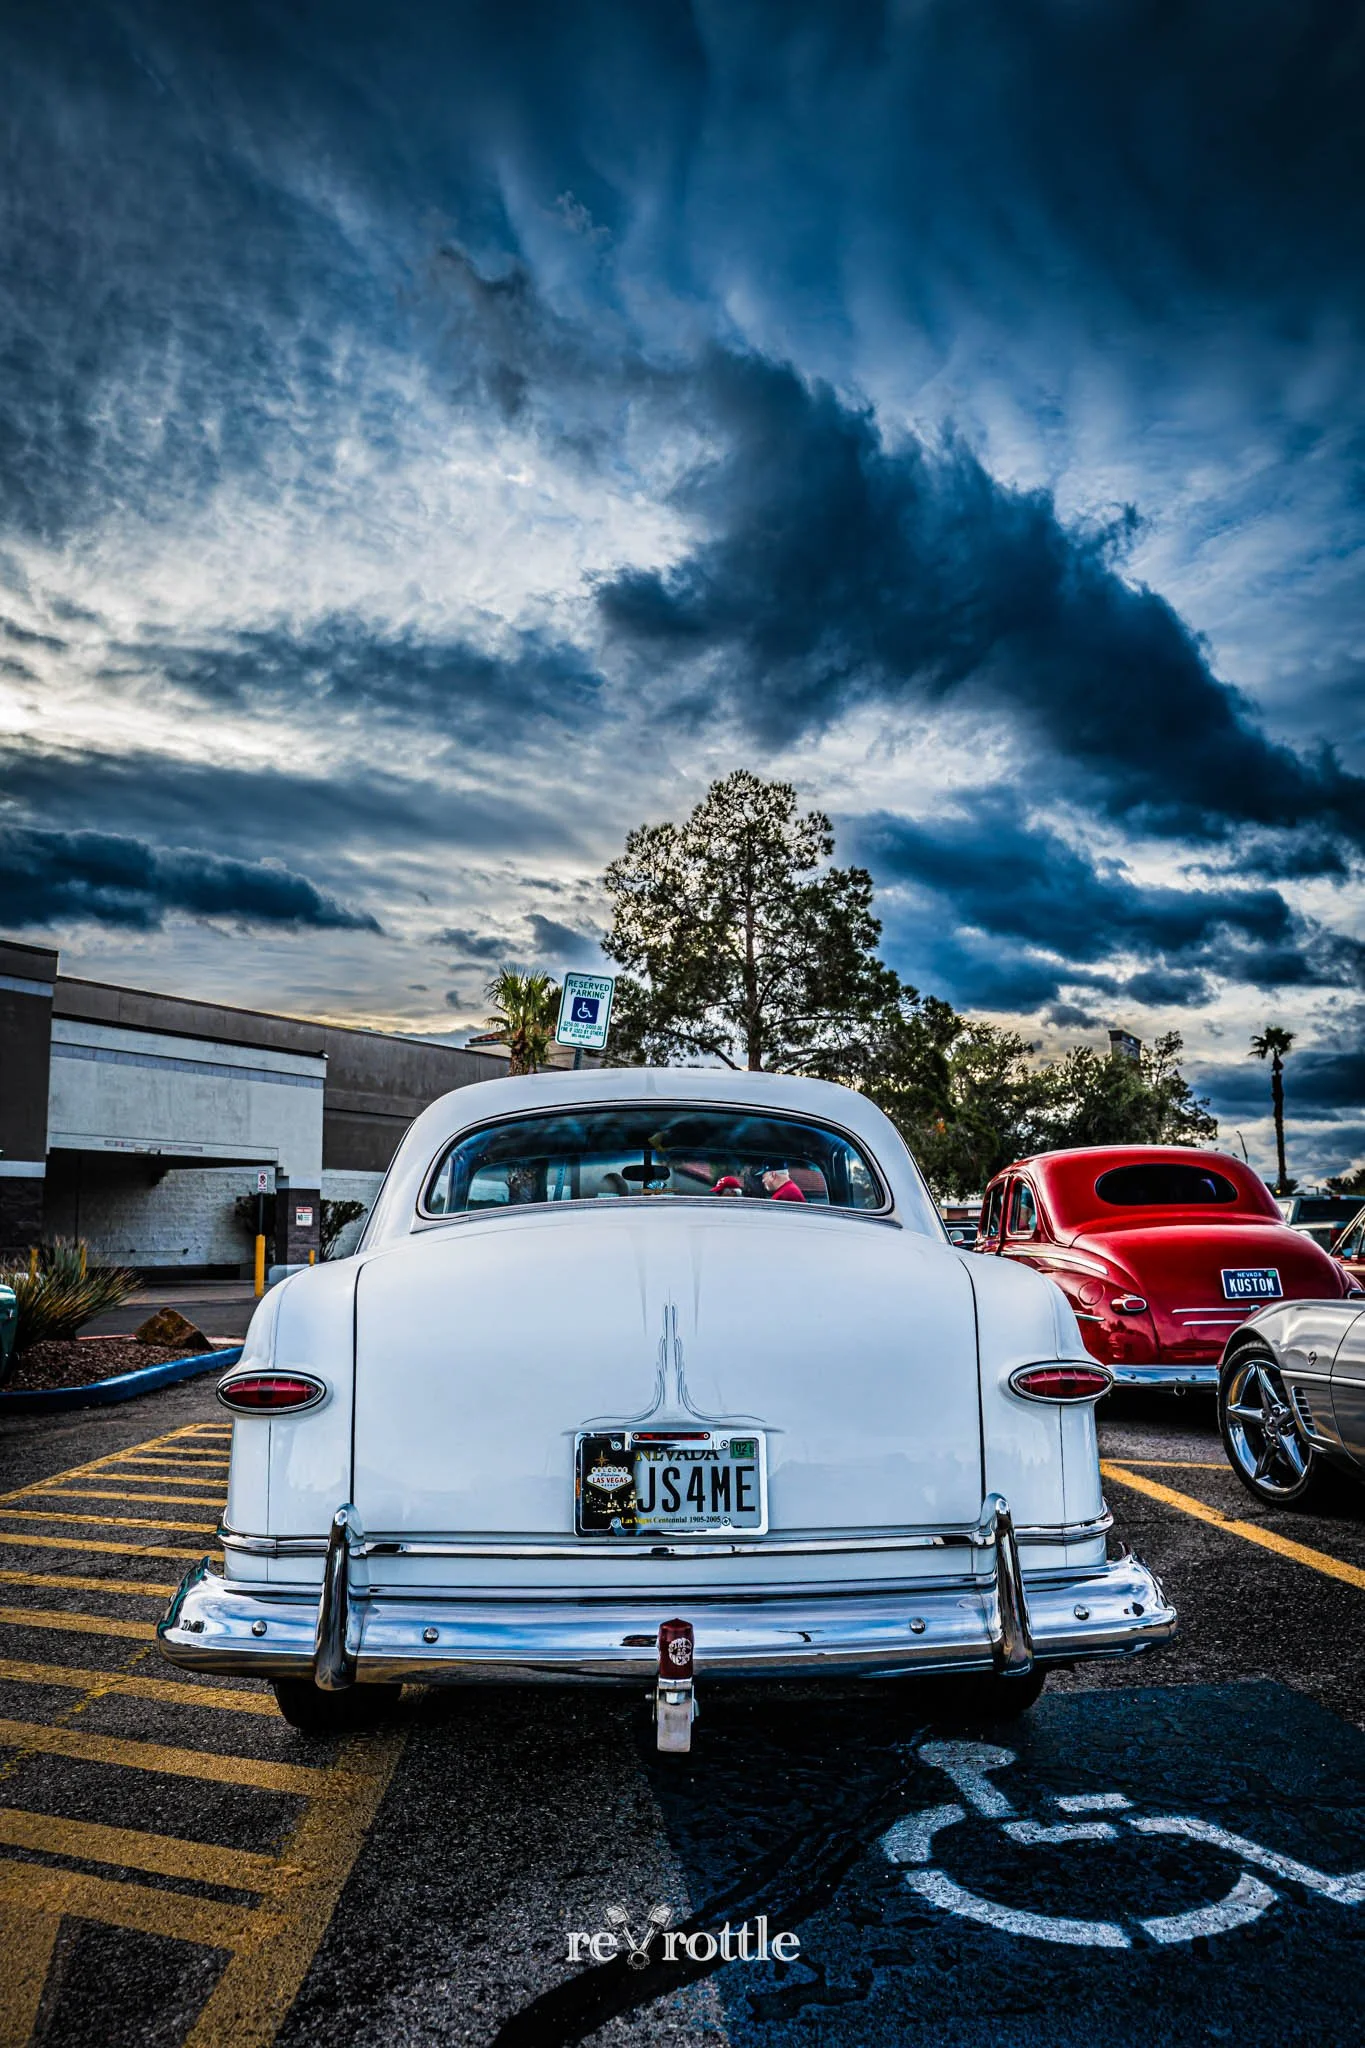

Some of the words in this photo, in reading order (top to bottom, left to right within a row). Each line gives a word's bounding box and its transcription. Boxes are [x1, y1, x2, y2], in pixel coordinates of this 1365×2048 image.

[568, 979, 610, 992] RESERVED
[570, 988, 605, 999] PARKING
[1229, 1278, 1275, 1292] KUSTOM
[735, 1443, 747, 1452] 02
[635, 1450, 720, 1462] NEVADA
[636, 1465, 756, 1513] JS4ME
[621, 1516, 633, 1524] Las
[634, 1516, 652, 1525] Vegas
